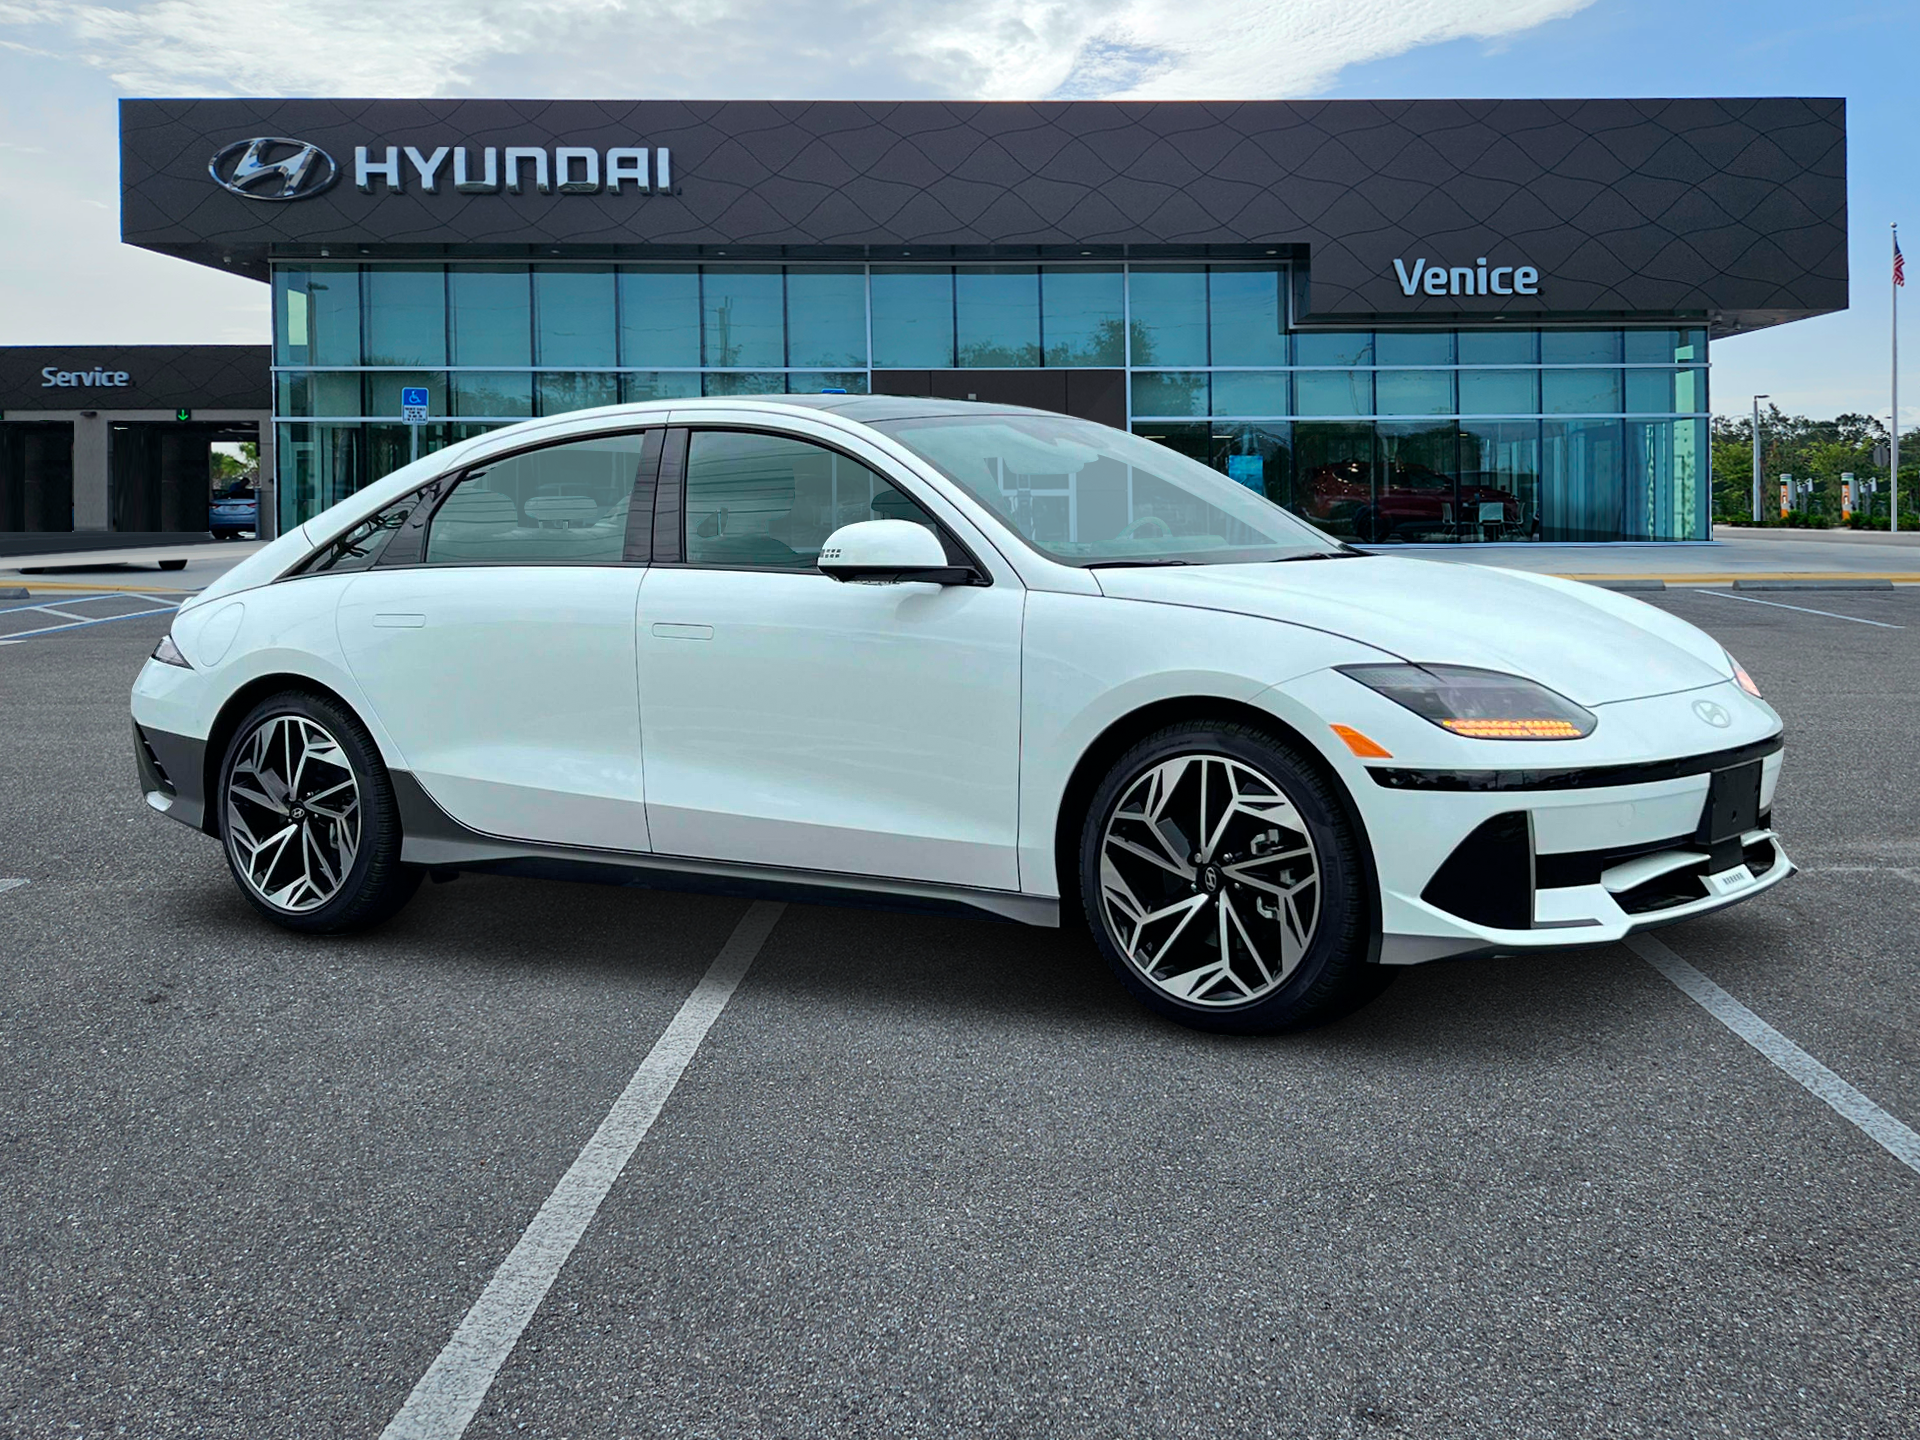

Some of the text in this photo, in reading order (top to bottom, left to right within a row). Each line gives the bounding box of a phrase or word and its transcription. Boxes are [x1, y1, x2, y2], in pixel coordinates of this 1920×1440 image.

[355, 146, 671, 194] HYUNDAI
[1393, 257, 1539, 295] Venice
[41, 366, 130, 387] Service
